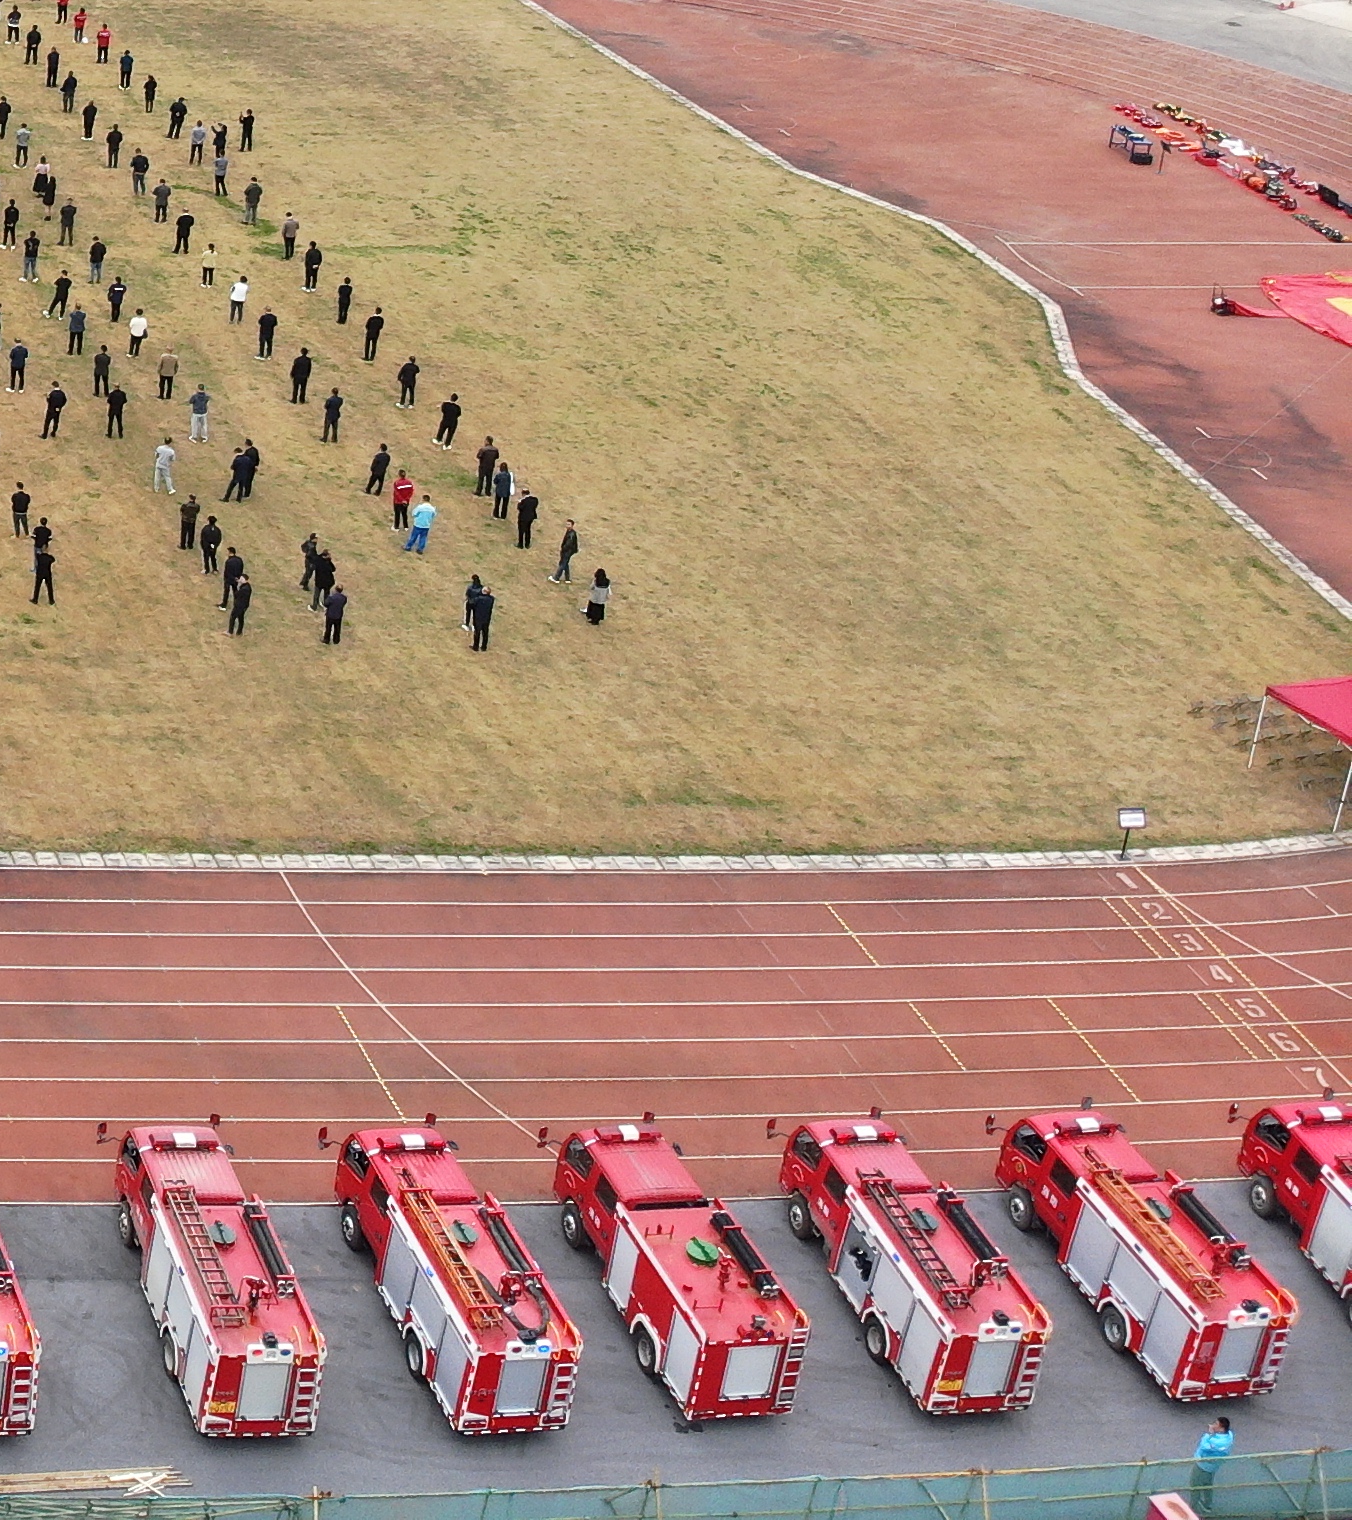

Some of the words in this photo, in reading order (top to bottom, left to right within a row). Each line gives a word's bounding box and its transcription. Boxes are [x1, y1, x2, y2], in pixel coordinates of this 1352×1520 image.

[1116, 872, 1138, 889] 1
[1141, 902, 1173, 920] 2
[1173, 933, 1204, 952] 3
[1209, 964, 1234, 983] 4
[1234, 998, 1268, 1018] 5
[1268, 1032, 1301, 1052] 6
[1300, 1067, 1330, 1088] 7
